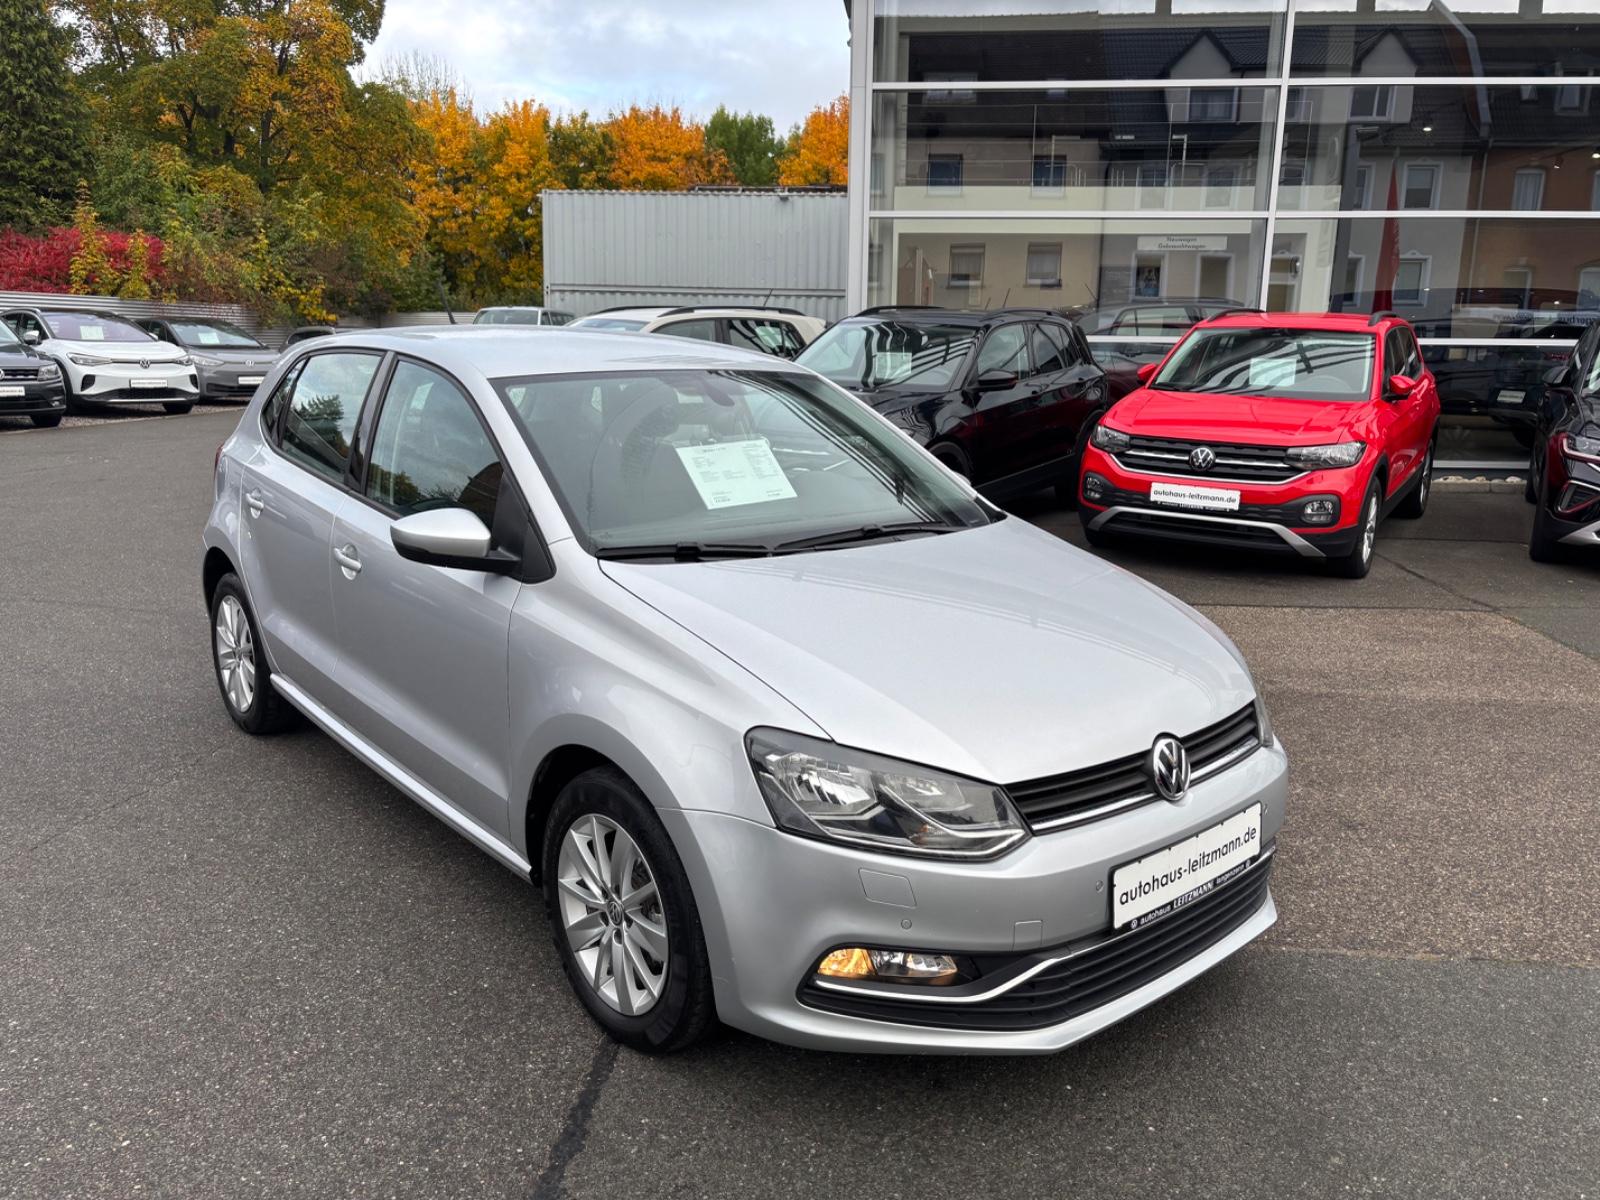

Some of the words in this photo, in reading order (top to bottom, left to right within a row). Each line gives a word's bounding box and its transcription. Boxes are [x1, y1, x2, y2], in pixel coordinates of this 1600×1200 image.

[1153, 489, 1237, 504] autohaus-leitzmann.de
[1119, 826, 1257, 905] autohaus-leitzmann.de
[1140, 905, 1172, 924] autohaus
[1173, 881, 1215, 908] LEITZMANN
